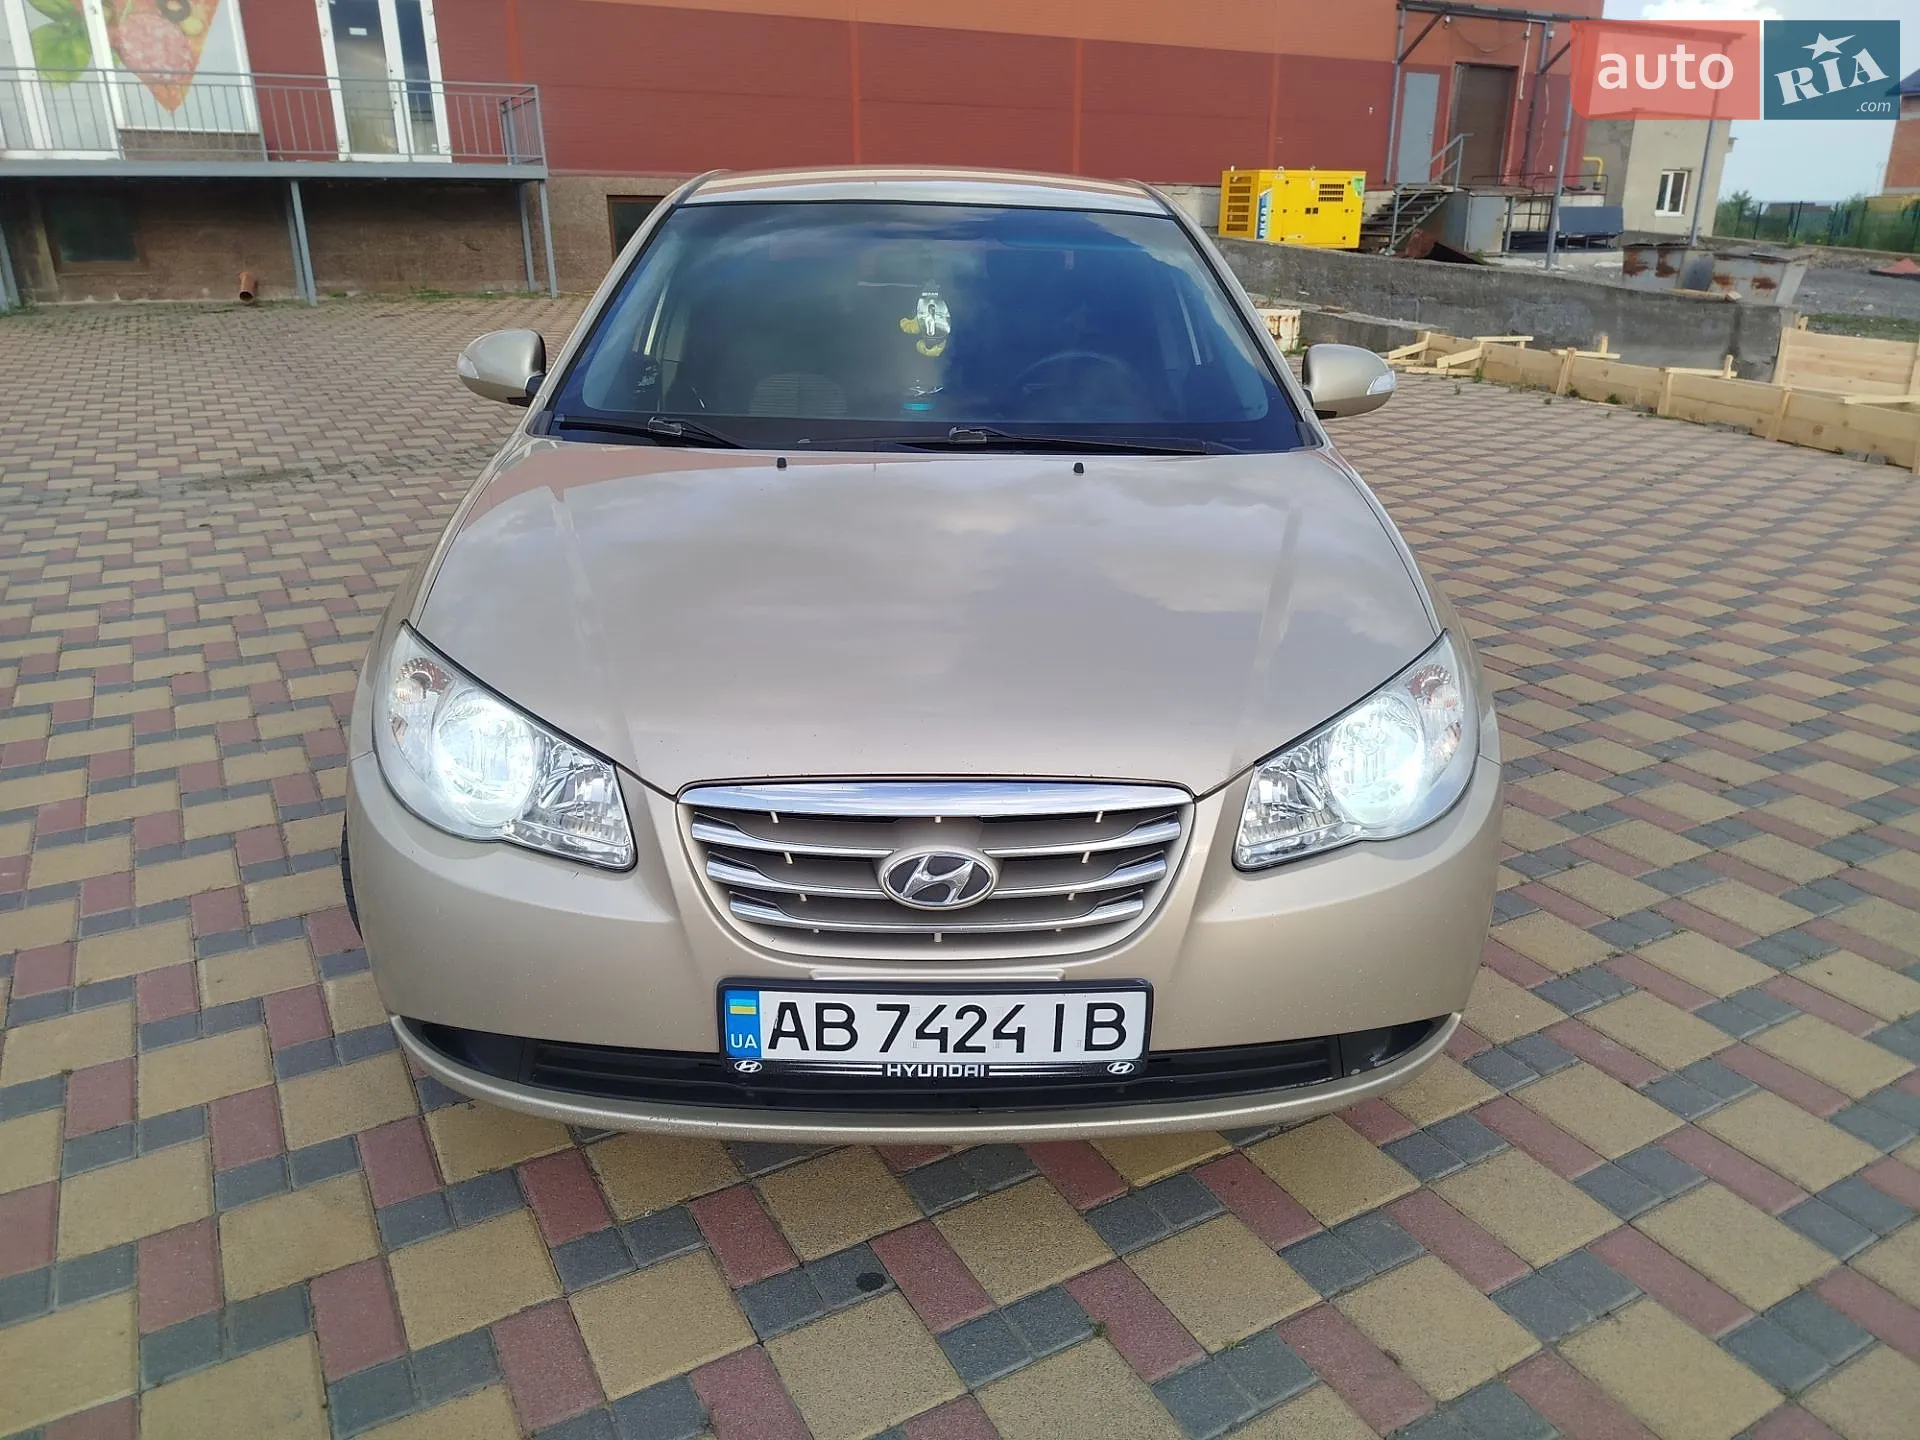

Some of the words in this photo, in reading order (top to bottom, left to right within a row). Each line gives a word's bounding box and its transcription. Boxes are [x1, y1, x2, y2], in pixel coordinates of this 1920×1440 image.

[767, 1001, 859, 1052] AB
[876, 1003, 1026, 1053] 7424
[1052, 1002, 1127, 1053] IB
[730, 1033, 758, 1049] UA
[886, 1064, 985, 1078] HYUNDAI
